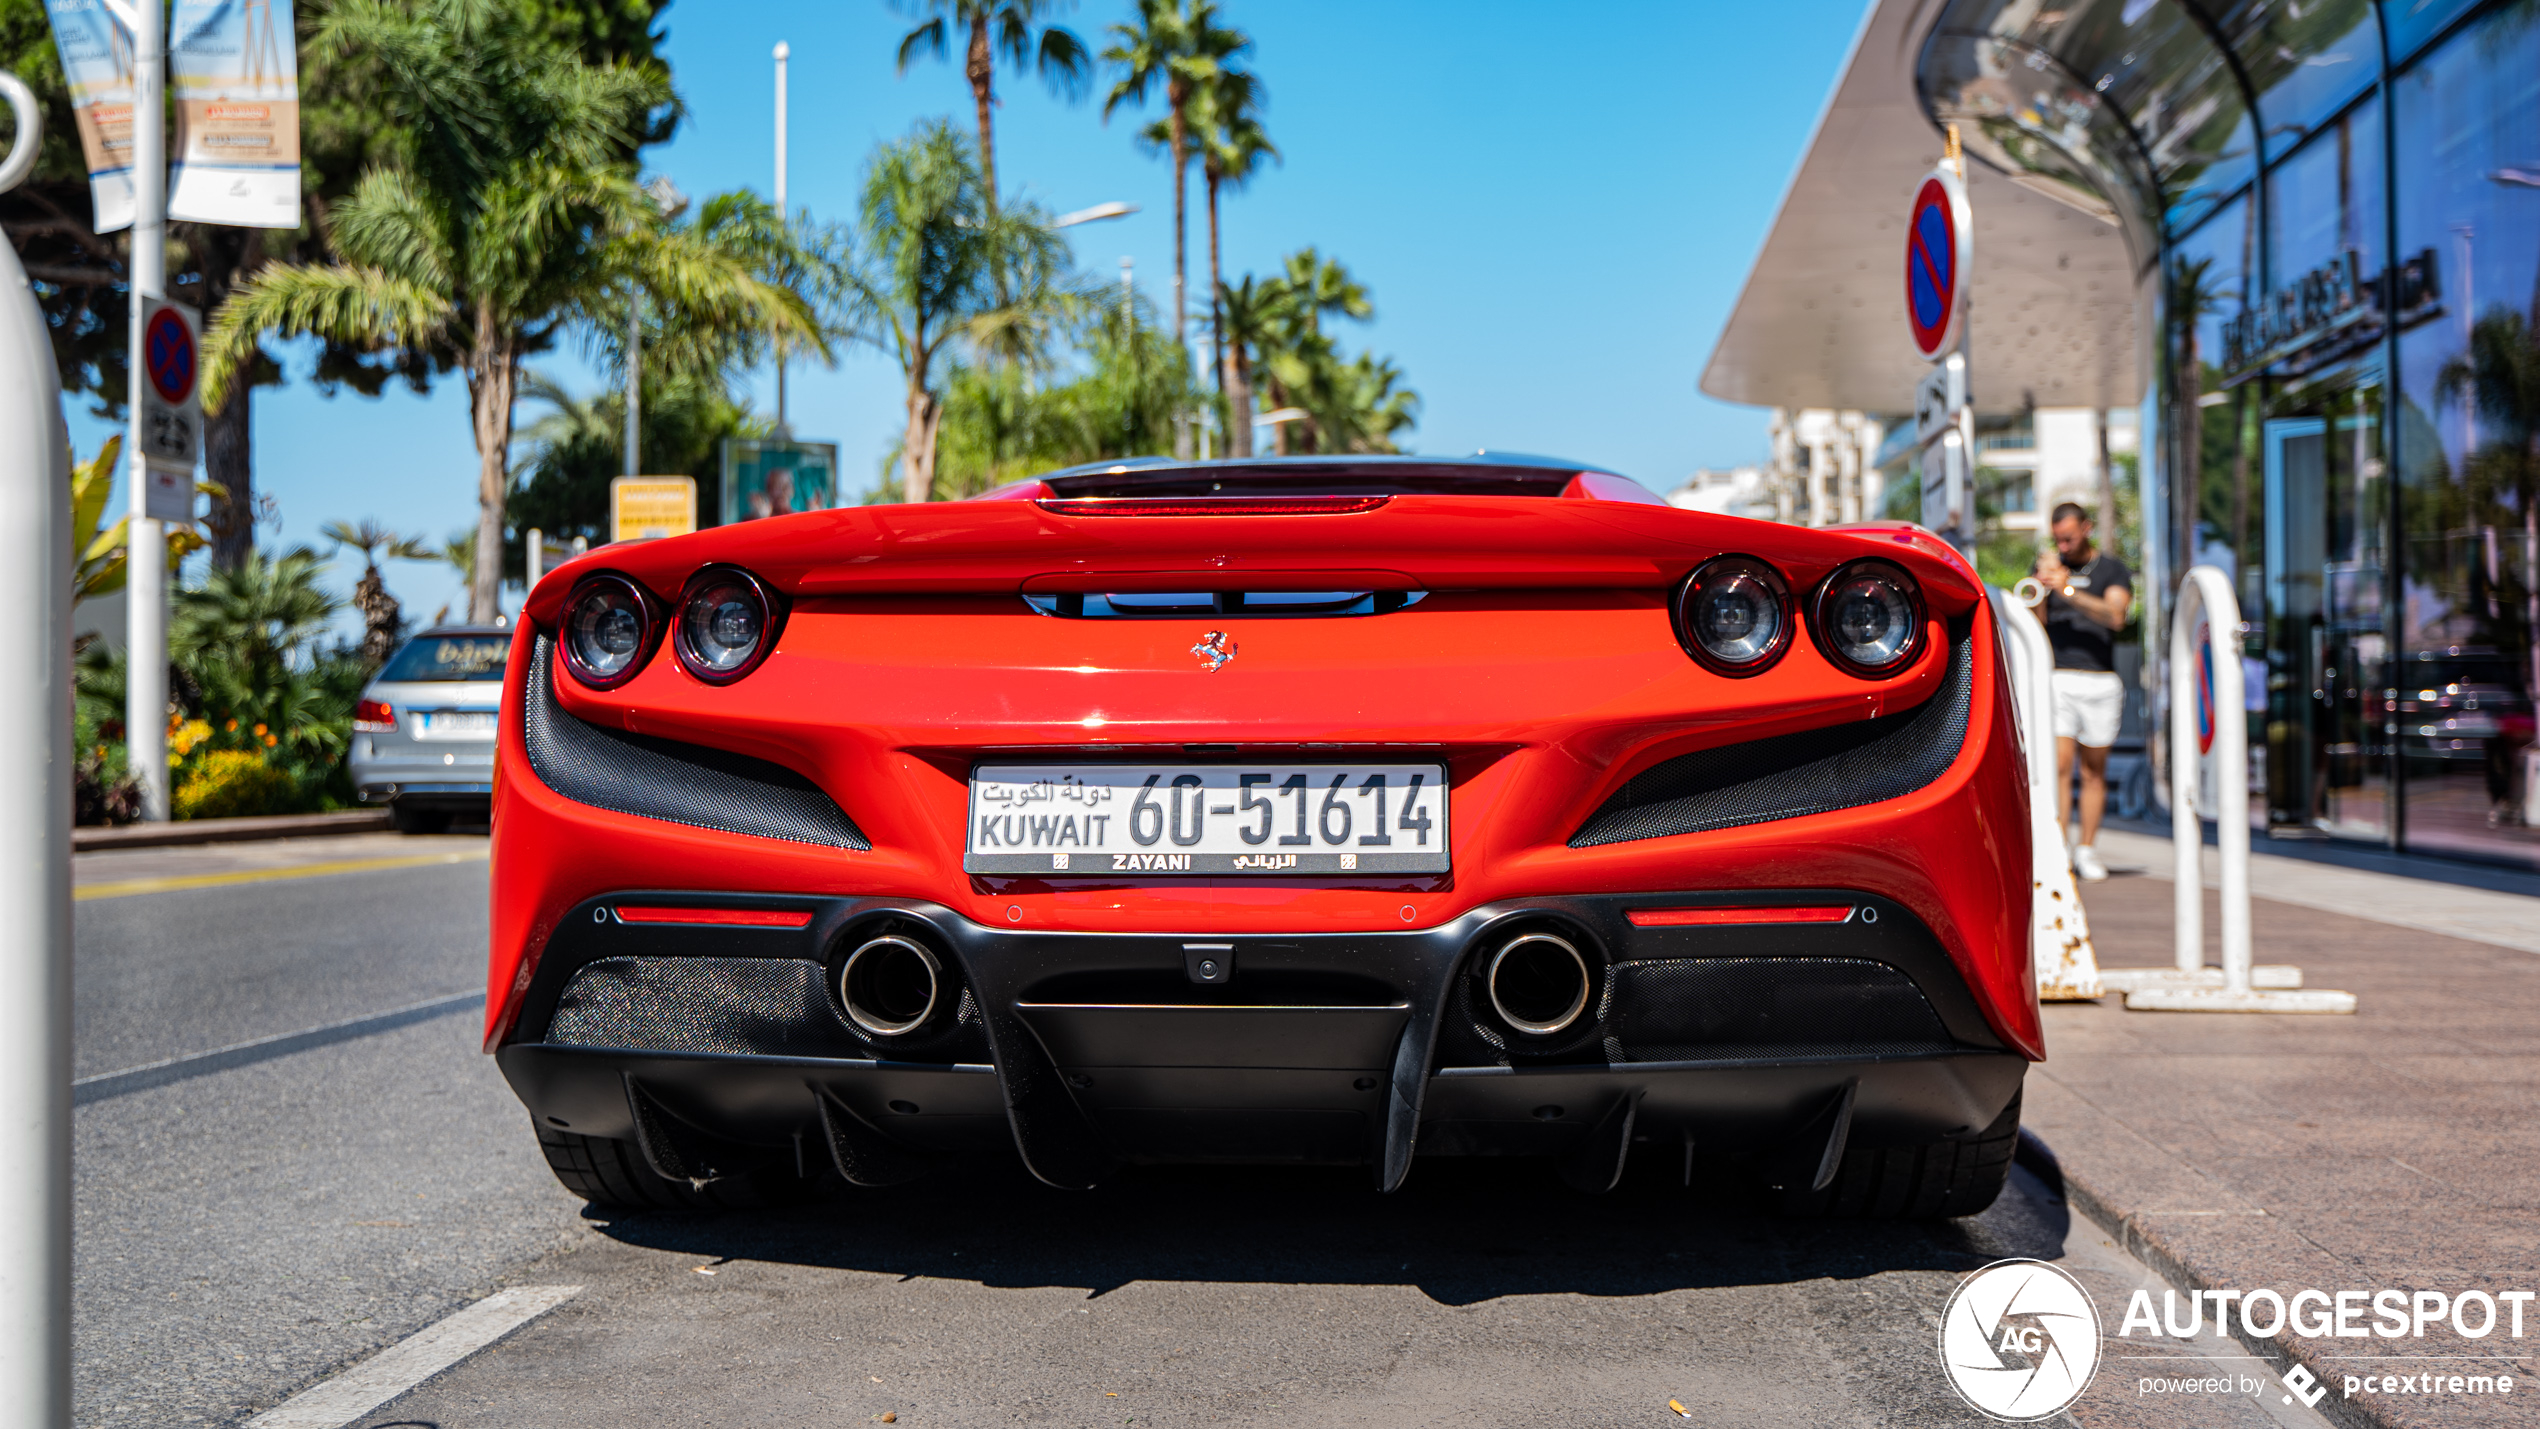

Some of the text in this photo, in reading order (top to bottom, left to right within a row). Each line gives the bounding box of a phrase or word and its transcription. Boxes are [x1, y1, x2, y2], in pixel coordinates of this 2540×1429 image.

[982, 774, 1112, 809] دولة الكويت
[1129, 773, 1432, 847] 60-51614
[979, 814, 1111, 847] KUWAIT
[1112, 854, 1191, 870] ZAYANI
[1233, 854, 1297, 870] الزياني
